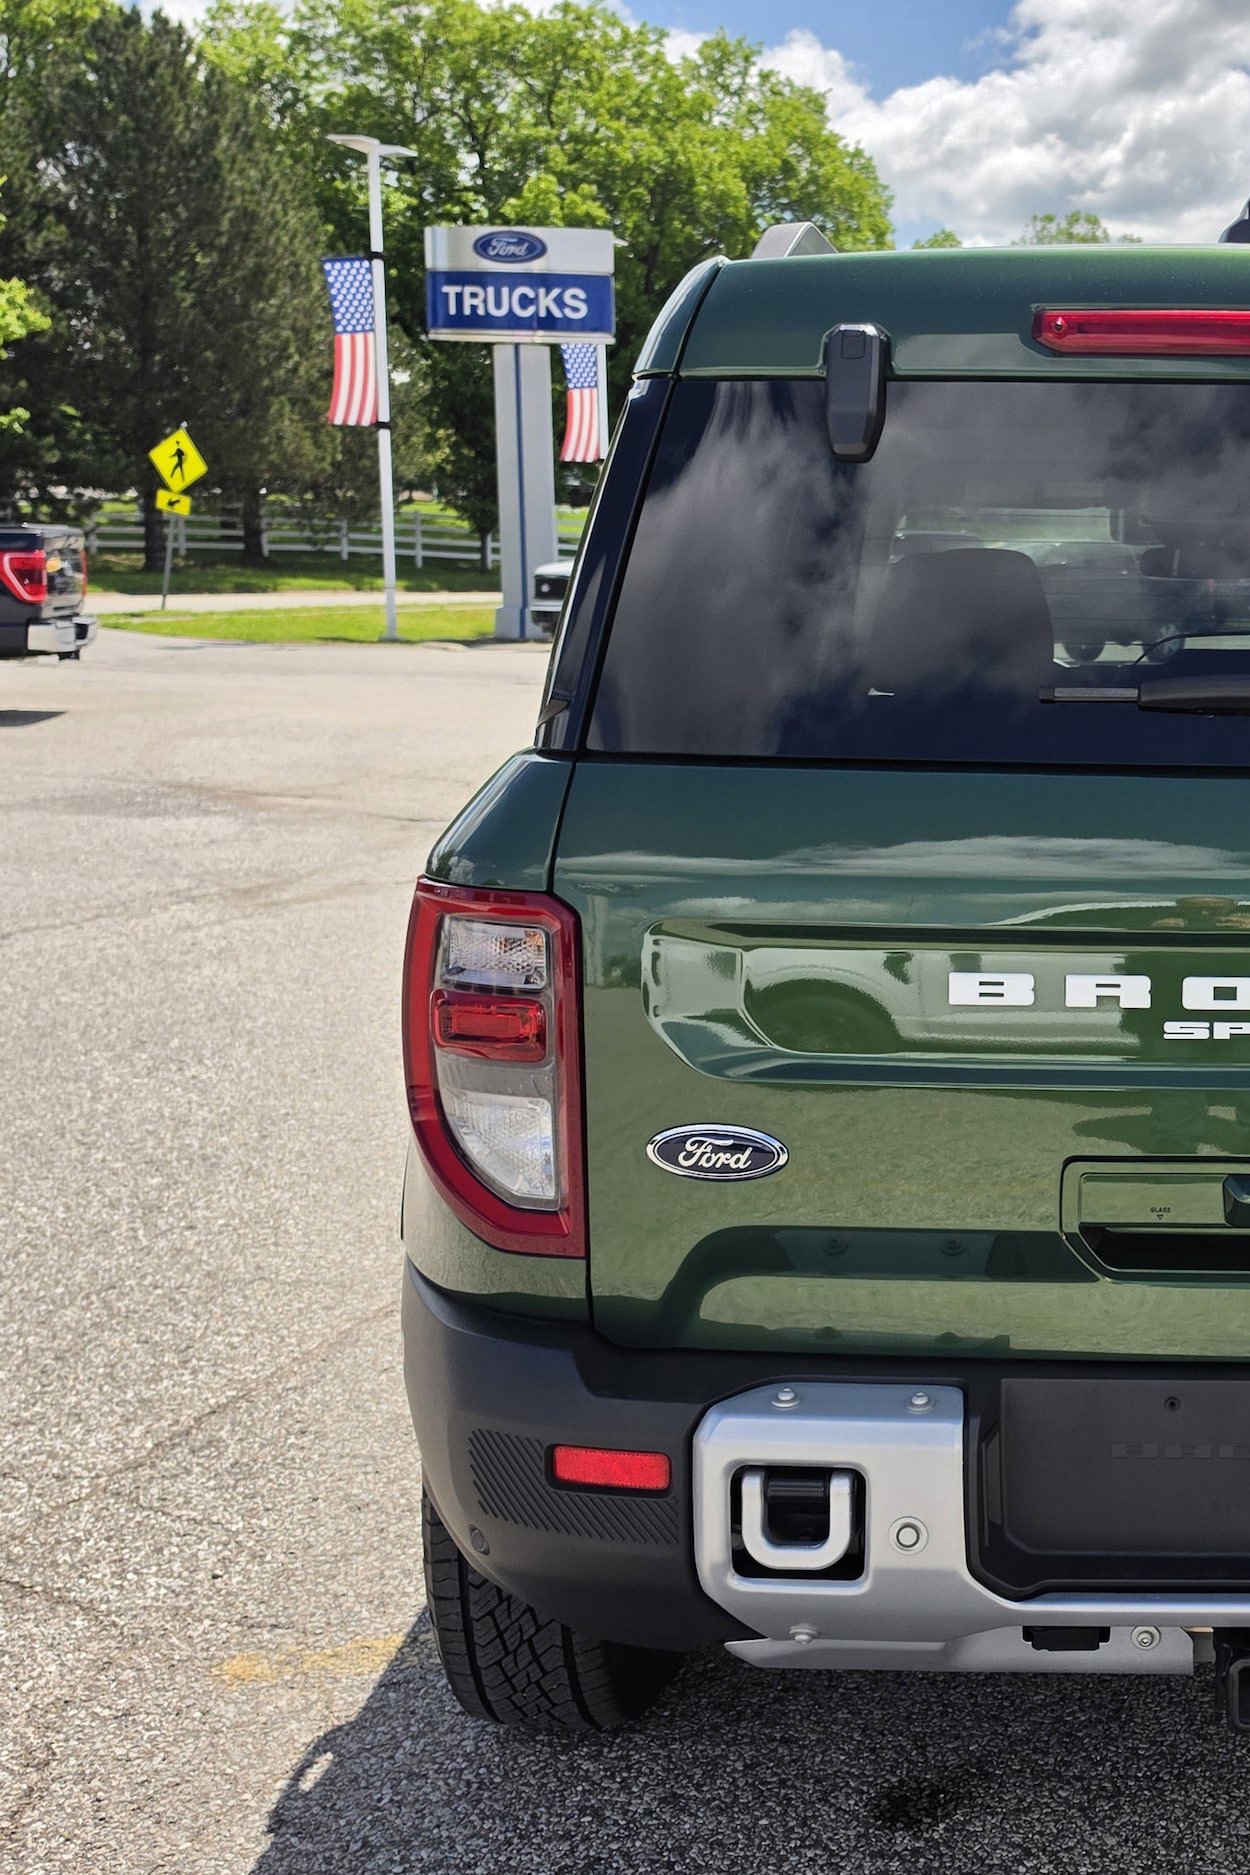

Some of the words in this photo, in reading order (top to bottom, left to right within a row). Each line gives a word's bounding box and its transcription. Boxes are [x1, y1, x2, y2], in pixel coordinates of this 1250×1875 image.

[487, 238, 529, 256] Ford
[441, 285, 588, 319] TRUCKS
[677, 1136, 752, 1170] Ford
